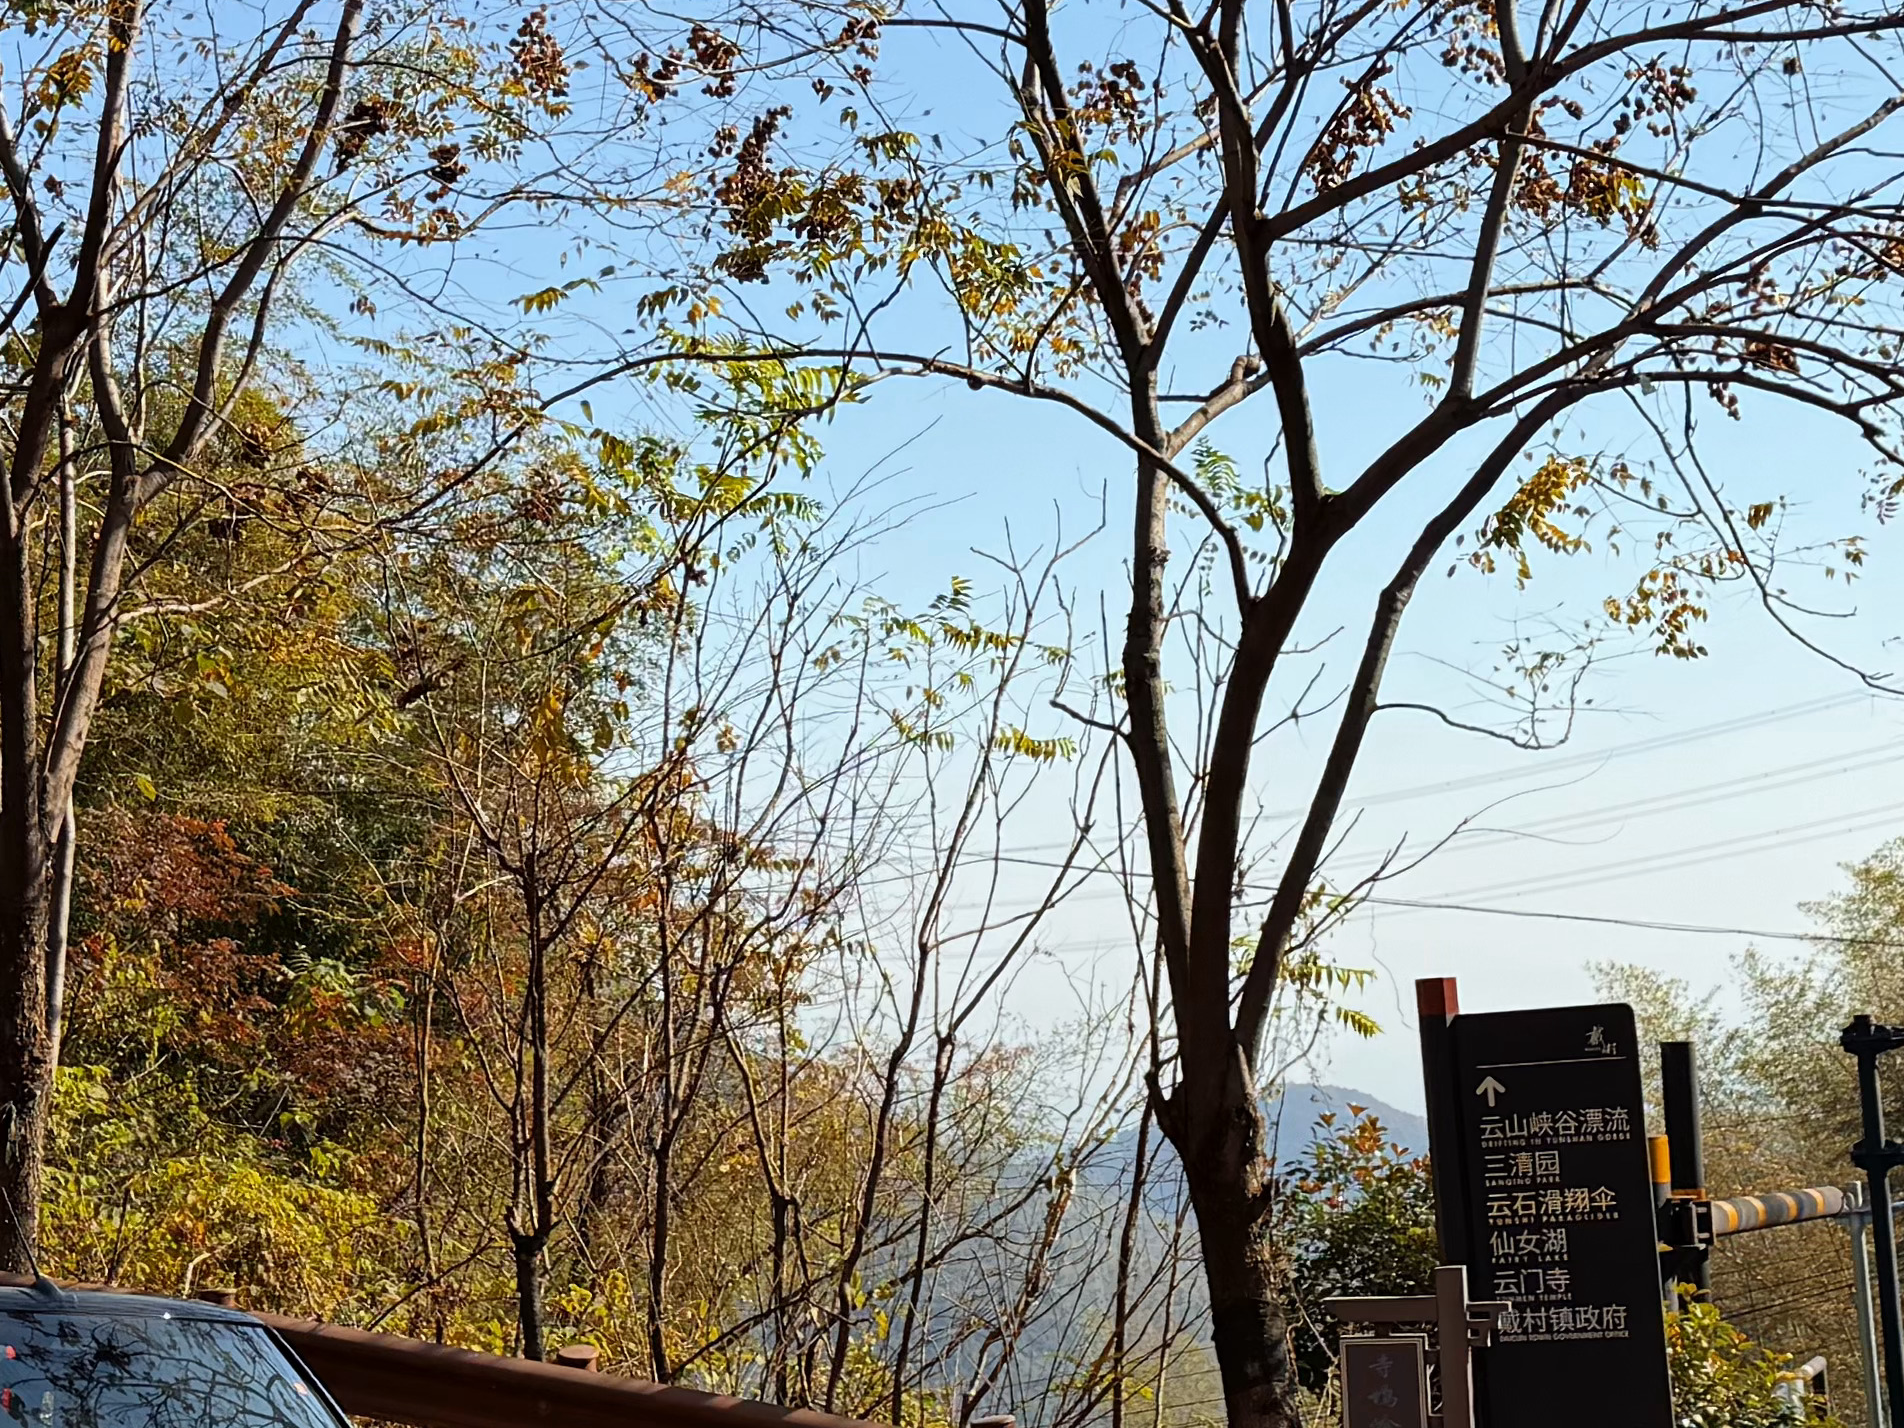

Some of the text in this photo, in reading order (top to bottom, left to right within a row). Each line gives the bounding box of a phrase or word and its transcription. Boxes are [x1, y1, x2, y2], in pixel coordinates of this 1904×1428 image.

[1480, 1106, 1630, 1139] 云山峡谷漂流
[1484, 1150, 1560, 1177] 三清园
[1486, 1186, 1617, 1217] 云石滑翔伞
[1489, 1228, 1567, 1256] 仙女湖
[1493, 1267, 1571, 1294] 云门寺
[1499, 1303, 1627, 1334] 戴村镇政府
